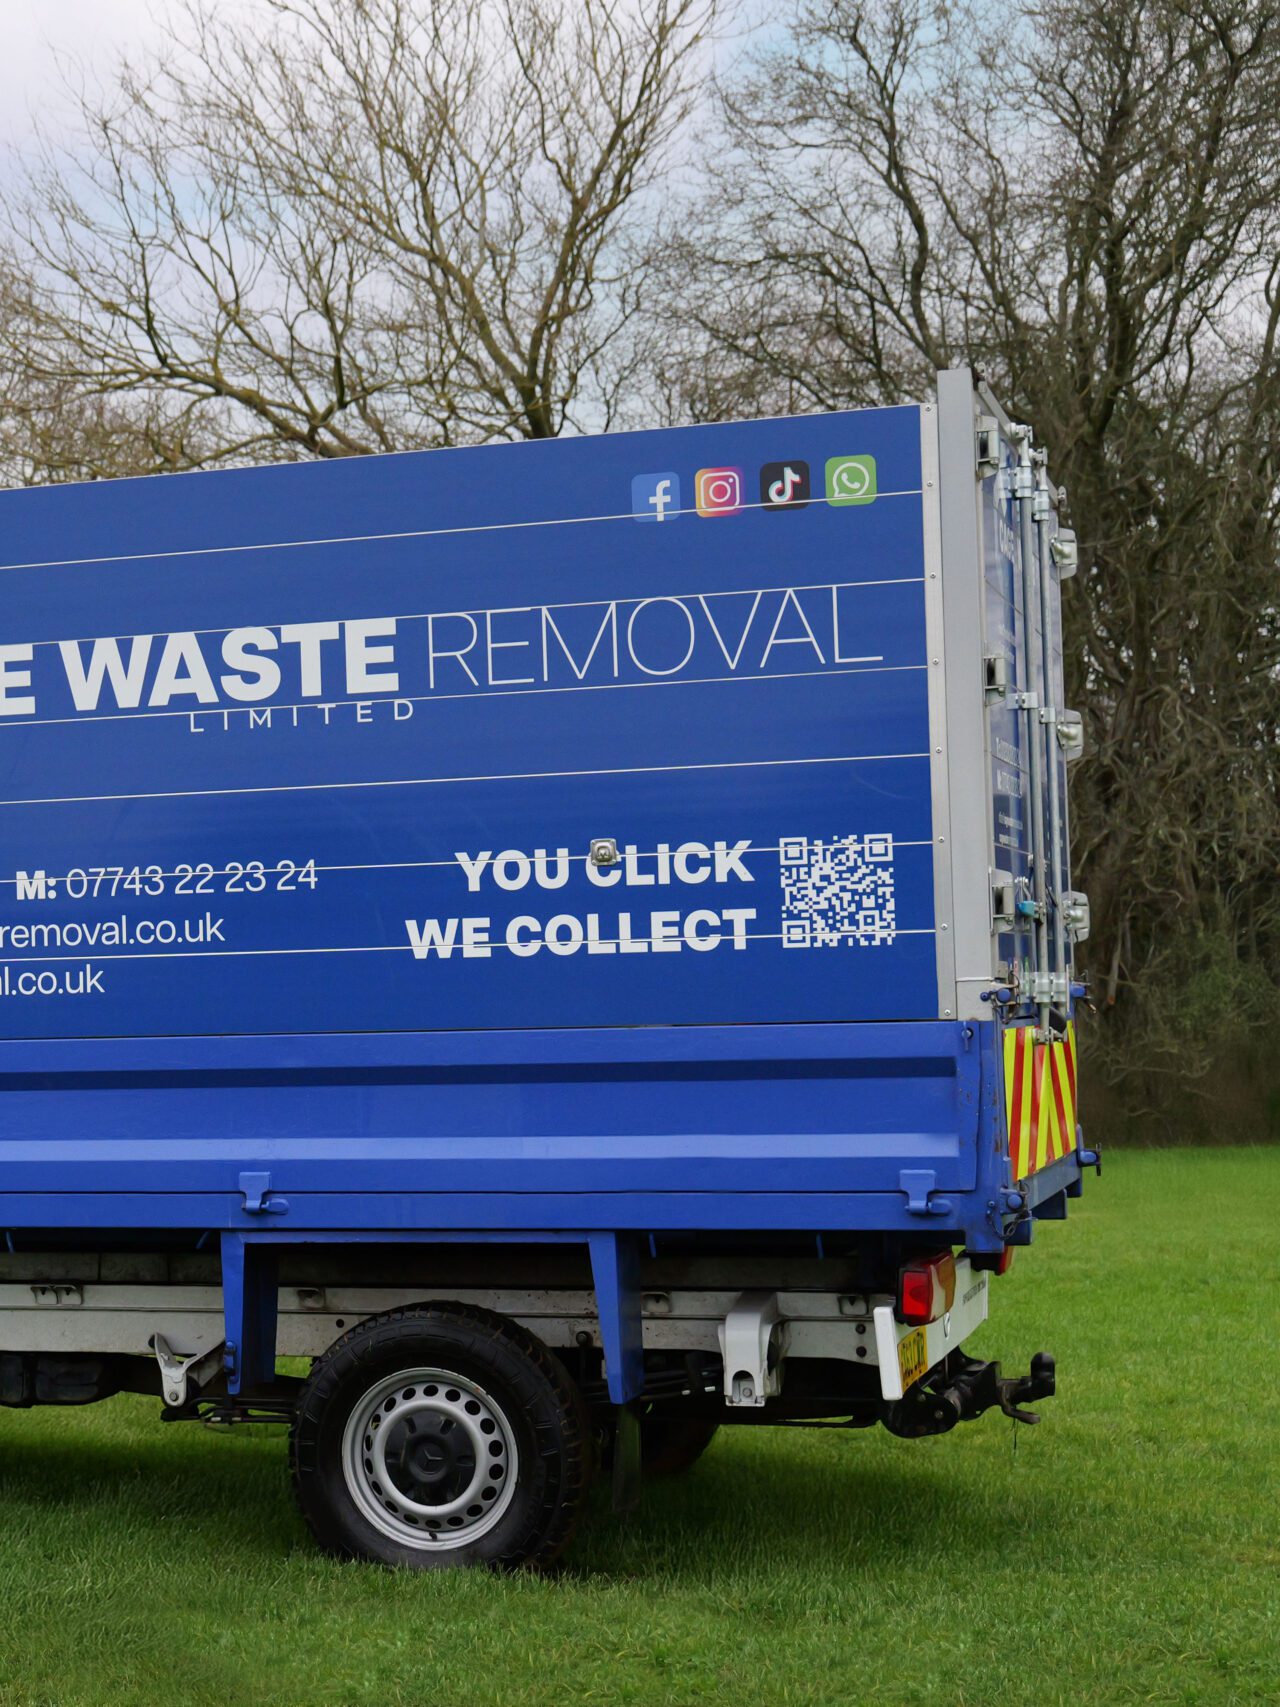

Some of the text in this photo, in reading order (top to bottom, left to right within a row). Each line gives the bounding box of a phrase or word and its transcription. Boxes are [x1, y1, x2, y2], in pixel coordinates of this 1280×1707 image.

[57, 617, 401, 712] WASTE
[427, 585, 884, 690] REMOVAL
[189, 700, 415, 733] LIMITED
[15, 870, 57, 901] M:
[65, 864, 165, 899] 07743
[173, 863, 216, 895] 22
[224, 861, 267, 894] 23
[275, 858, 319, 892] 24
[454, 840, 756, 893] YOU CLICK
[405, 907, 758, 960] WE COLLECT
